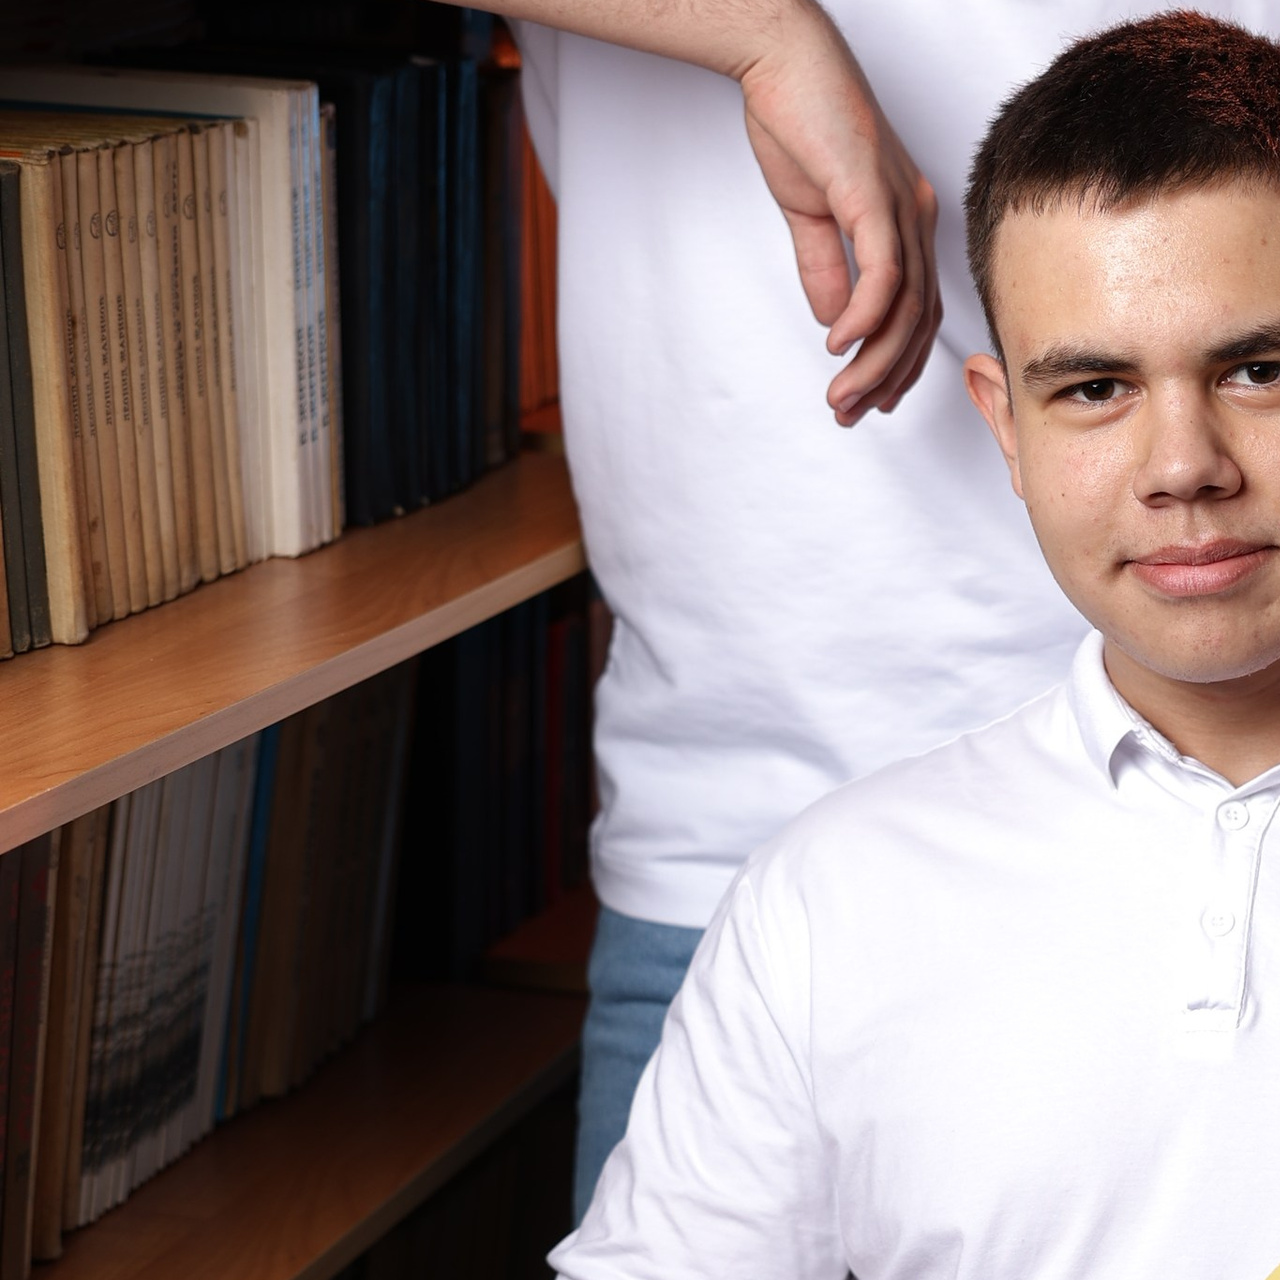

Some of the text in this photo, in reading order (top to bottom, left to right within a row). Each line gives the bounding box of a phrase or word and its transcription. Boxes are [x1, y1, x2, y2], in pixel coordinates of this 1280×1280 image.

[99, 295, 113, 425] ЛЕОНИД ЖАРИКОВ
[116, 294, 130, 422] ЛЕОНИД ЖАРИКОВ
